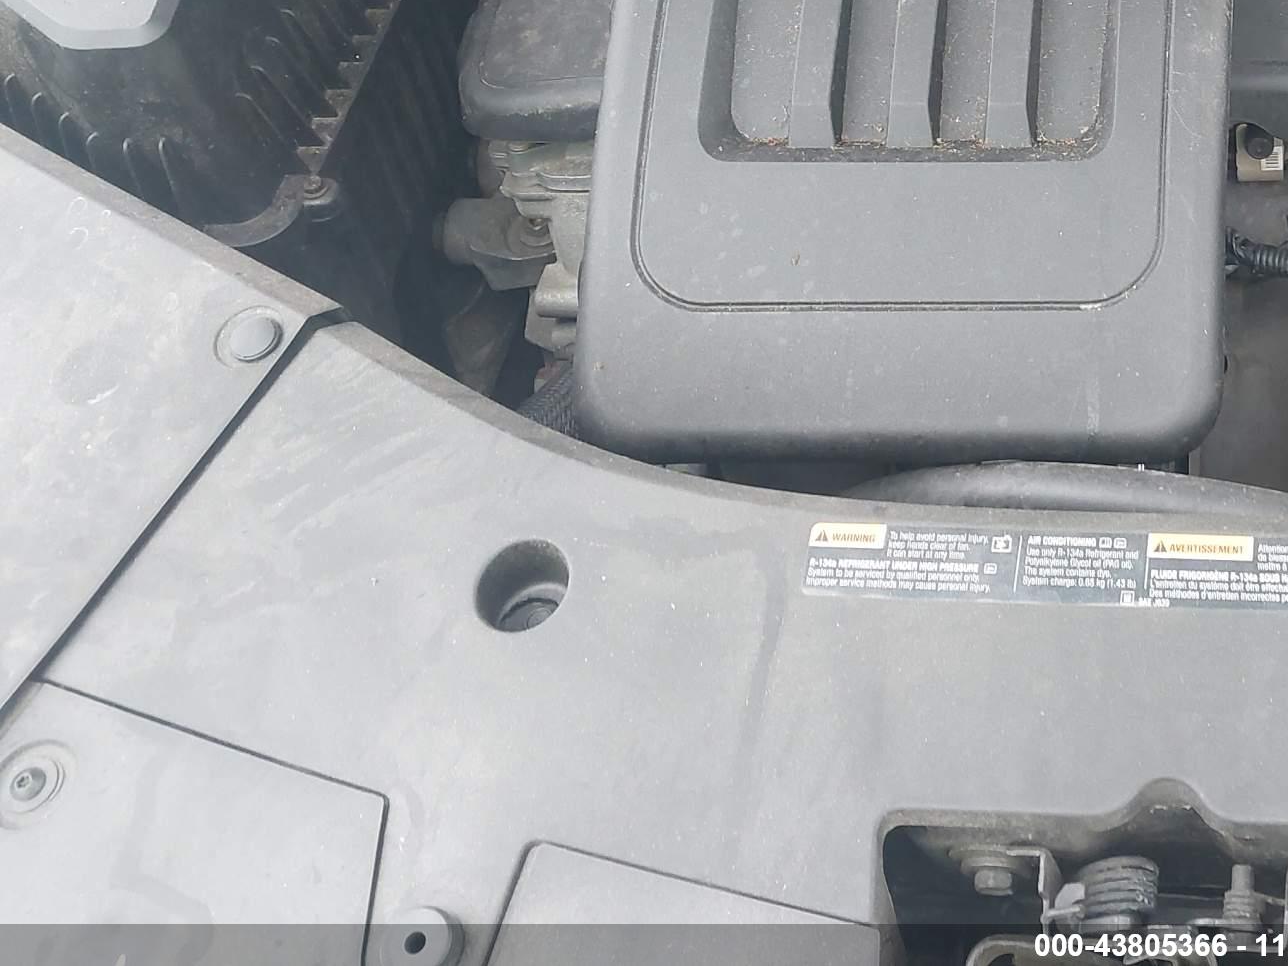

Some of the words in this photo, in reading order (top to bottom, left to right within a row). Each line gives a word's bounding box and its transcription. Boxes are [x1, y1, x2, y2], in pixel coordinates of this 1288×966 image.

[832, 533, 876, 543] WARNING
[1028, 535, 1041, 545] AIR
[1043, 535, 1096, 546] CONDITIONING
[1169, 543, 1243, 554] AVERTISSEMENT
[939, 562, 979, 573] PRESSURE
